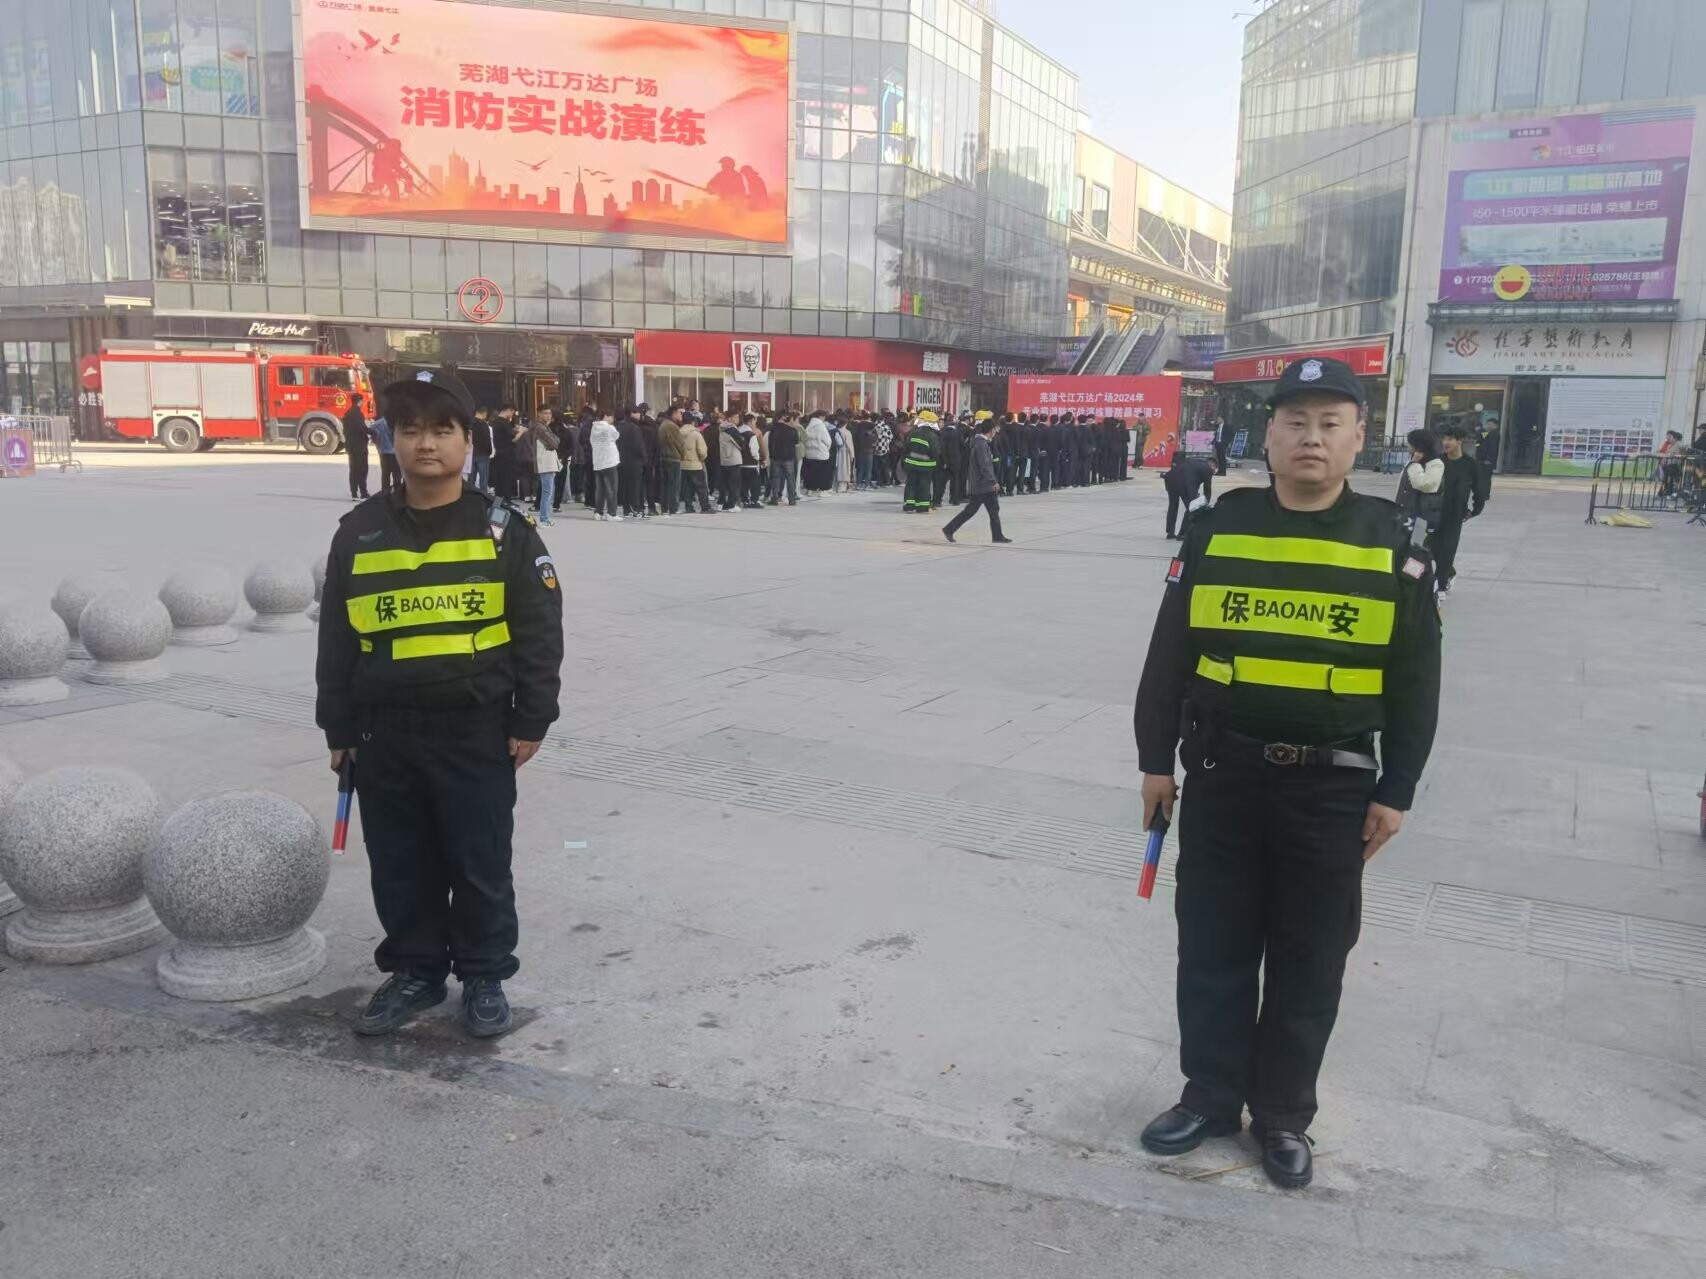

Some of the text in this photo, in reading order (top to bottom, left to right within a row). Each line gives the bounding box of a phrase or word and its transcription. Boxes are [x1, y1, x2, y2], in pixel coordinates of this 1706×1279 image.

[458, 63, 659, 97] 芜湖弋江万达广场
[399, 85, 707, 146] 消防实战演练
[248, 322, 313, 336] Pizza Hut
[1561, 351, 1634, 359] EDUCATION
[976, 359, 997, 376] 卡旺卡
[916, 386, 942, 405] FINGER
[1040, 392, 1145, 403] 芜湖弋江万达广场2024年
